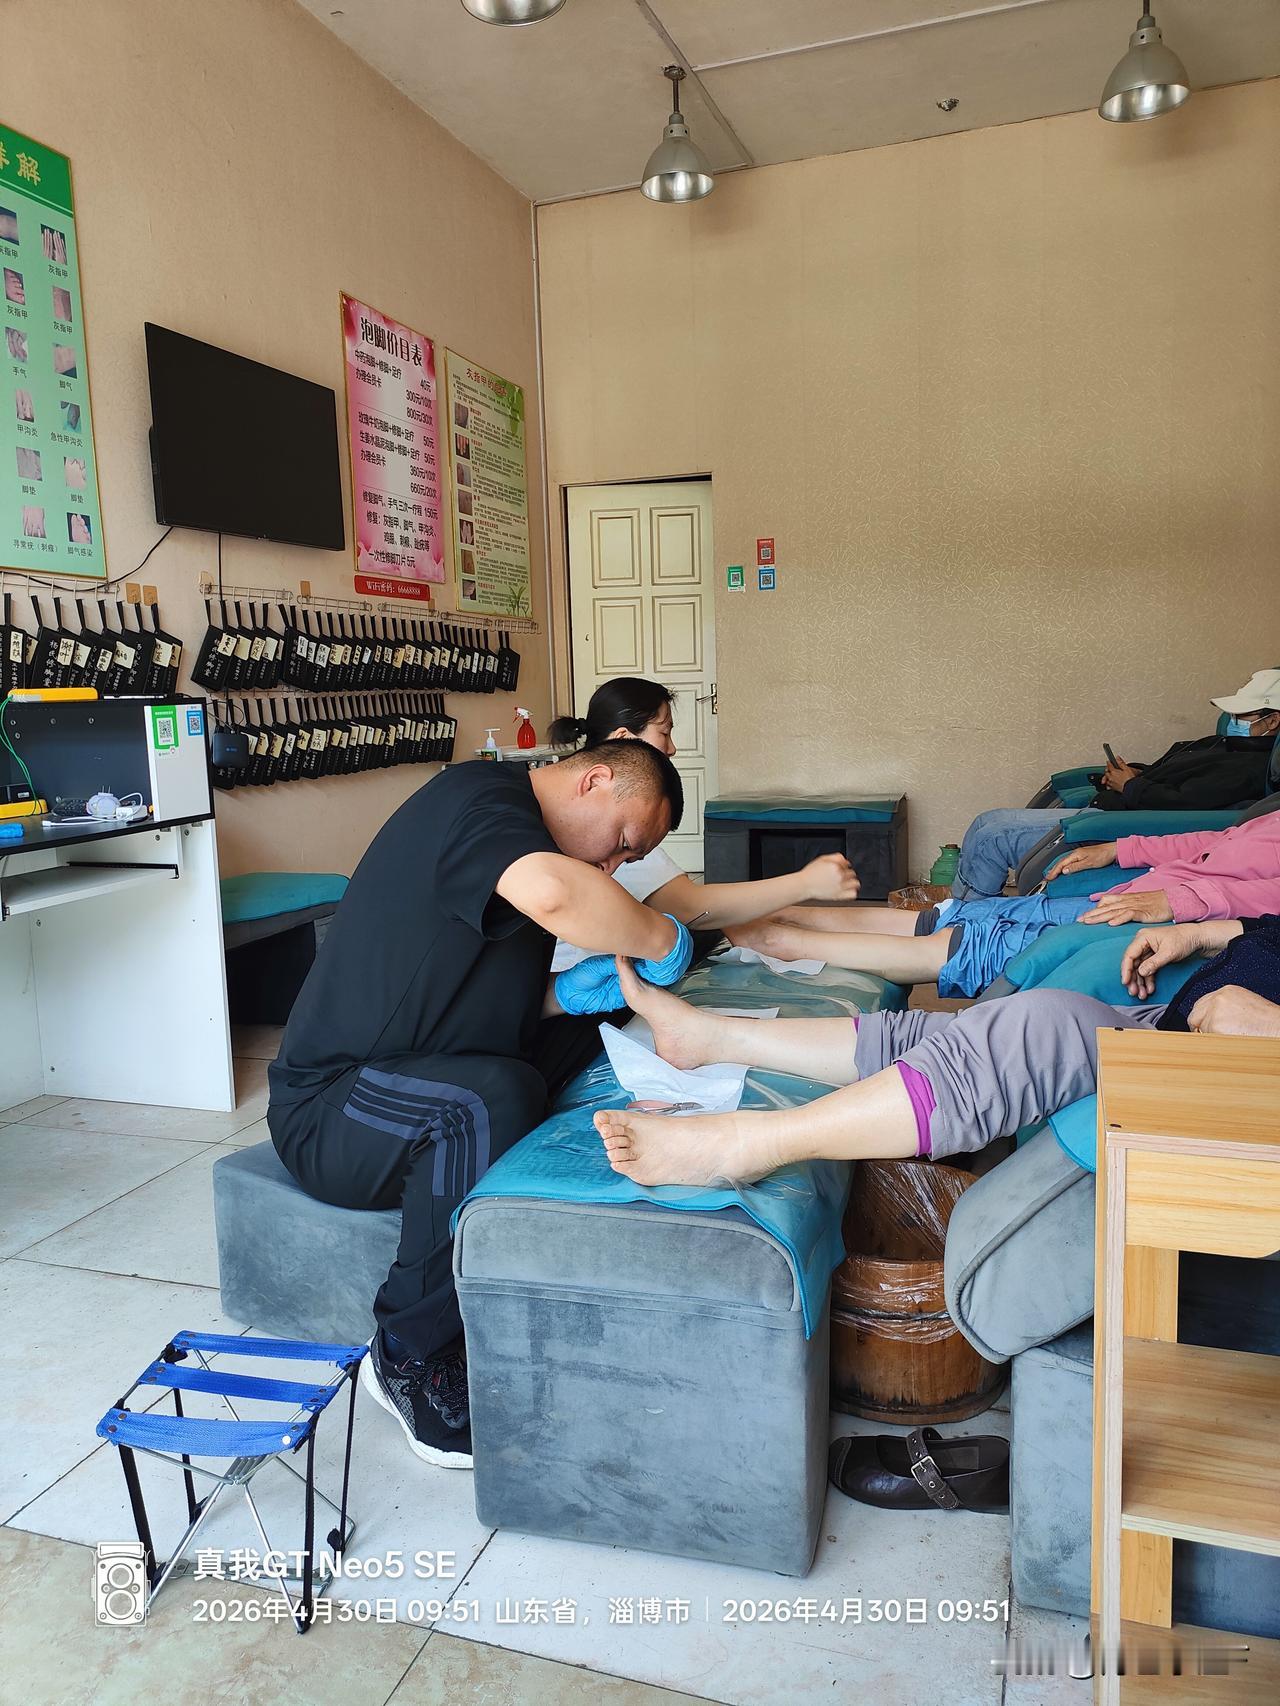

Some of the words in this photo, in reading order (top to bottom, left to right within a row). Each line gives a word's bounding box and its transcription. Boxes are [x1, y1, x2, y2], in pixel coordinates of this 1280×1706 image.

[48, 264, 69, 278] 灰指甲
[7, 305, 28, 319] 灰指甲
[53, 321, 73, 334] 灰指甲
[360, 317, 422, 367] 泡脚价目表
[356, 368, 382, 388] 办理会员卡
[59, 380, 73, 391] 脚气
[17, 424, 39, 438] 甲沟炎
[50, 432, 84, 448] 急性甲沟炎
[360, 450, 386, 467] 办理会员卡
[424, 452, 436, 466] 50元
[21, 485, 37, 496] 脚垫
[424, 503, 438, 521] 150元
[67, 546, 93, 558] 脚气感染
